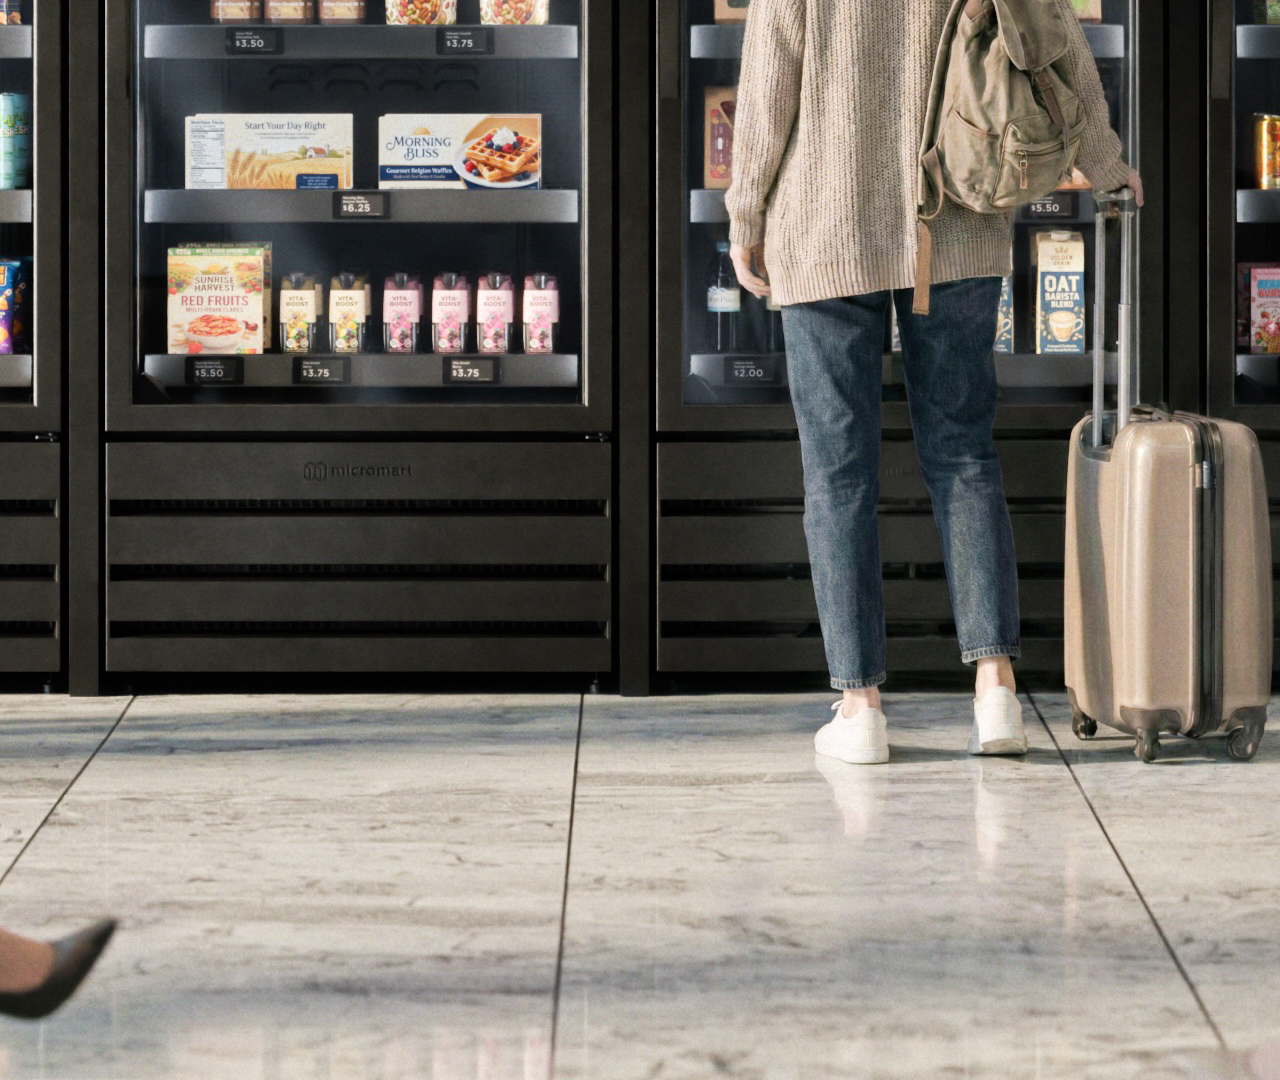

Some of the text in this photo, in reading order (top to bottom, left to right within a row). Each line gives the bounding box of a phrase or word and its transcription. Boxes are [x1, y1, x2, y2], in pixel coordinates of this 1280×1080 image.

[245, 121, 326, 131] Start Your Day Right
[386, 136, 451, 151] MORNING
[404, 148, 439, 161] BLISS
[343, 204, 370, 212] $6.25
[1031, 204, 1059, 212] $5.50
[194, 276, 235, 284] SUNRISE
[1044, 276, 1080, 292] OAT
[194, 284, 235, 292] HARVEST
[181, 296, 249, 306] RED FRUITS
[734, 369, 763, 377] $2.00
[332, 463, 412, 477] micromart
